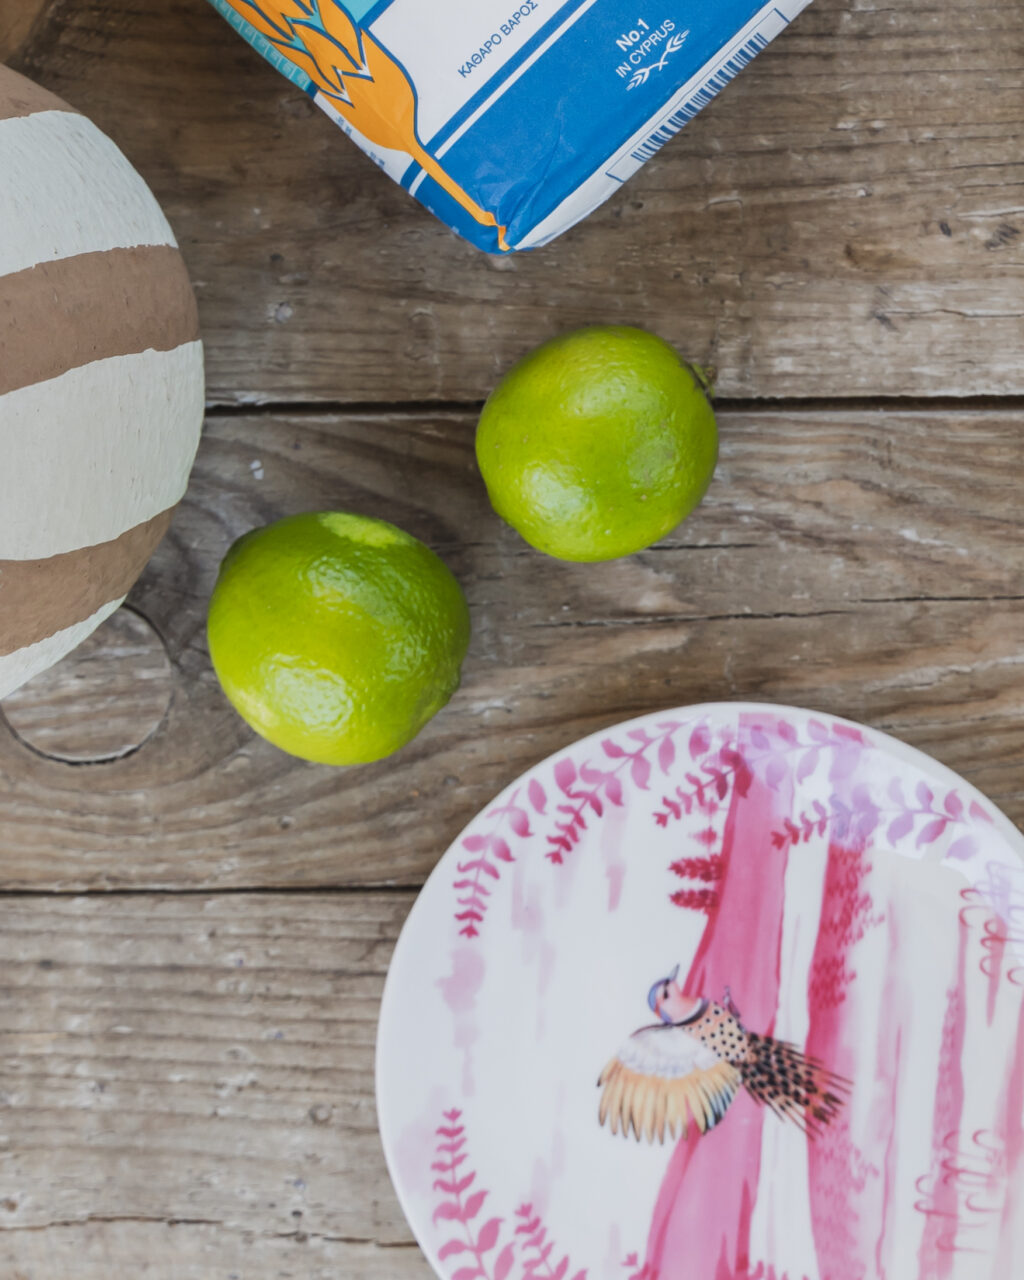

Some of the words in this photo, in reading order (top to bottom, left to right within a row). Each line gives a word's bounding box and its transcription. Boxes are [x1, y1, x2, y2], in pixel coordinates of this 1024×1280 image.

[615, 17, 651, 53] No.1
[615, 61, 633, 79] IN
[629, 19, 676, 65] CYPRUS
